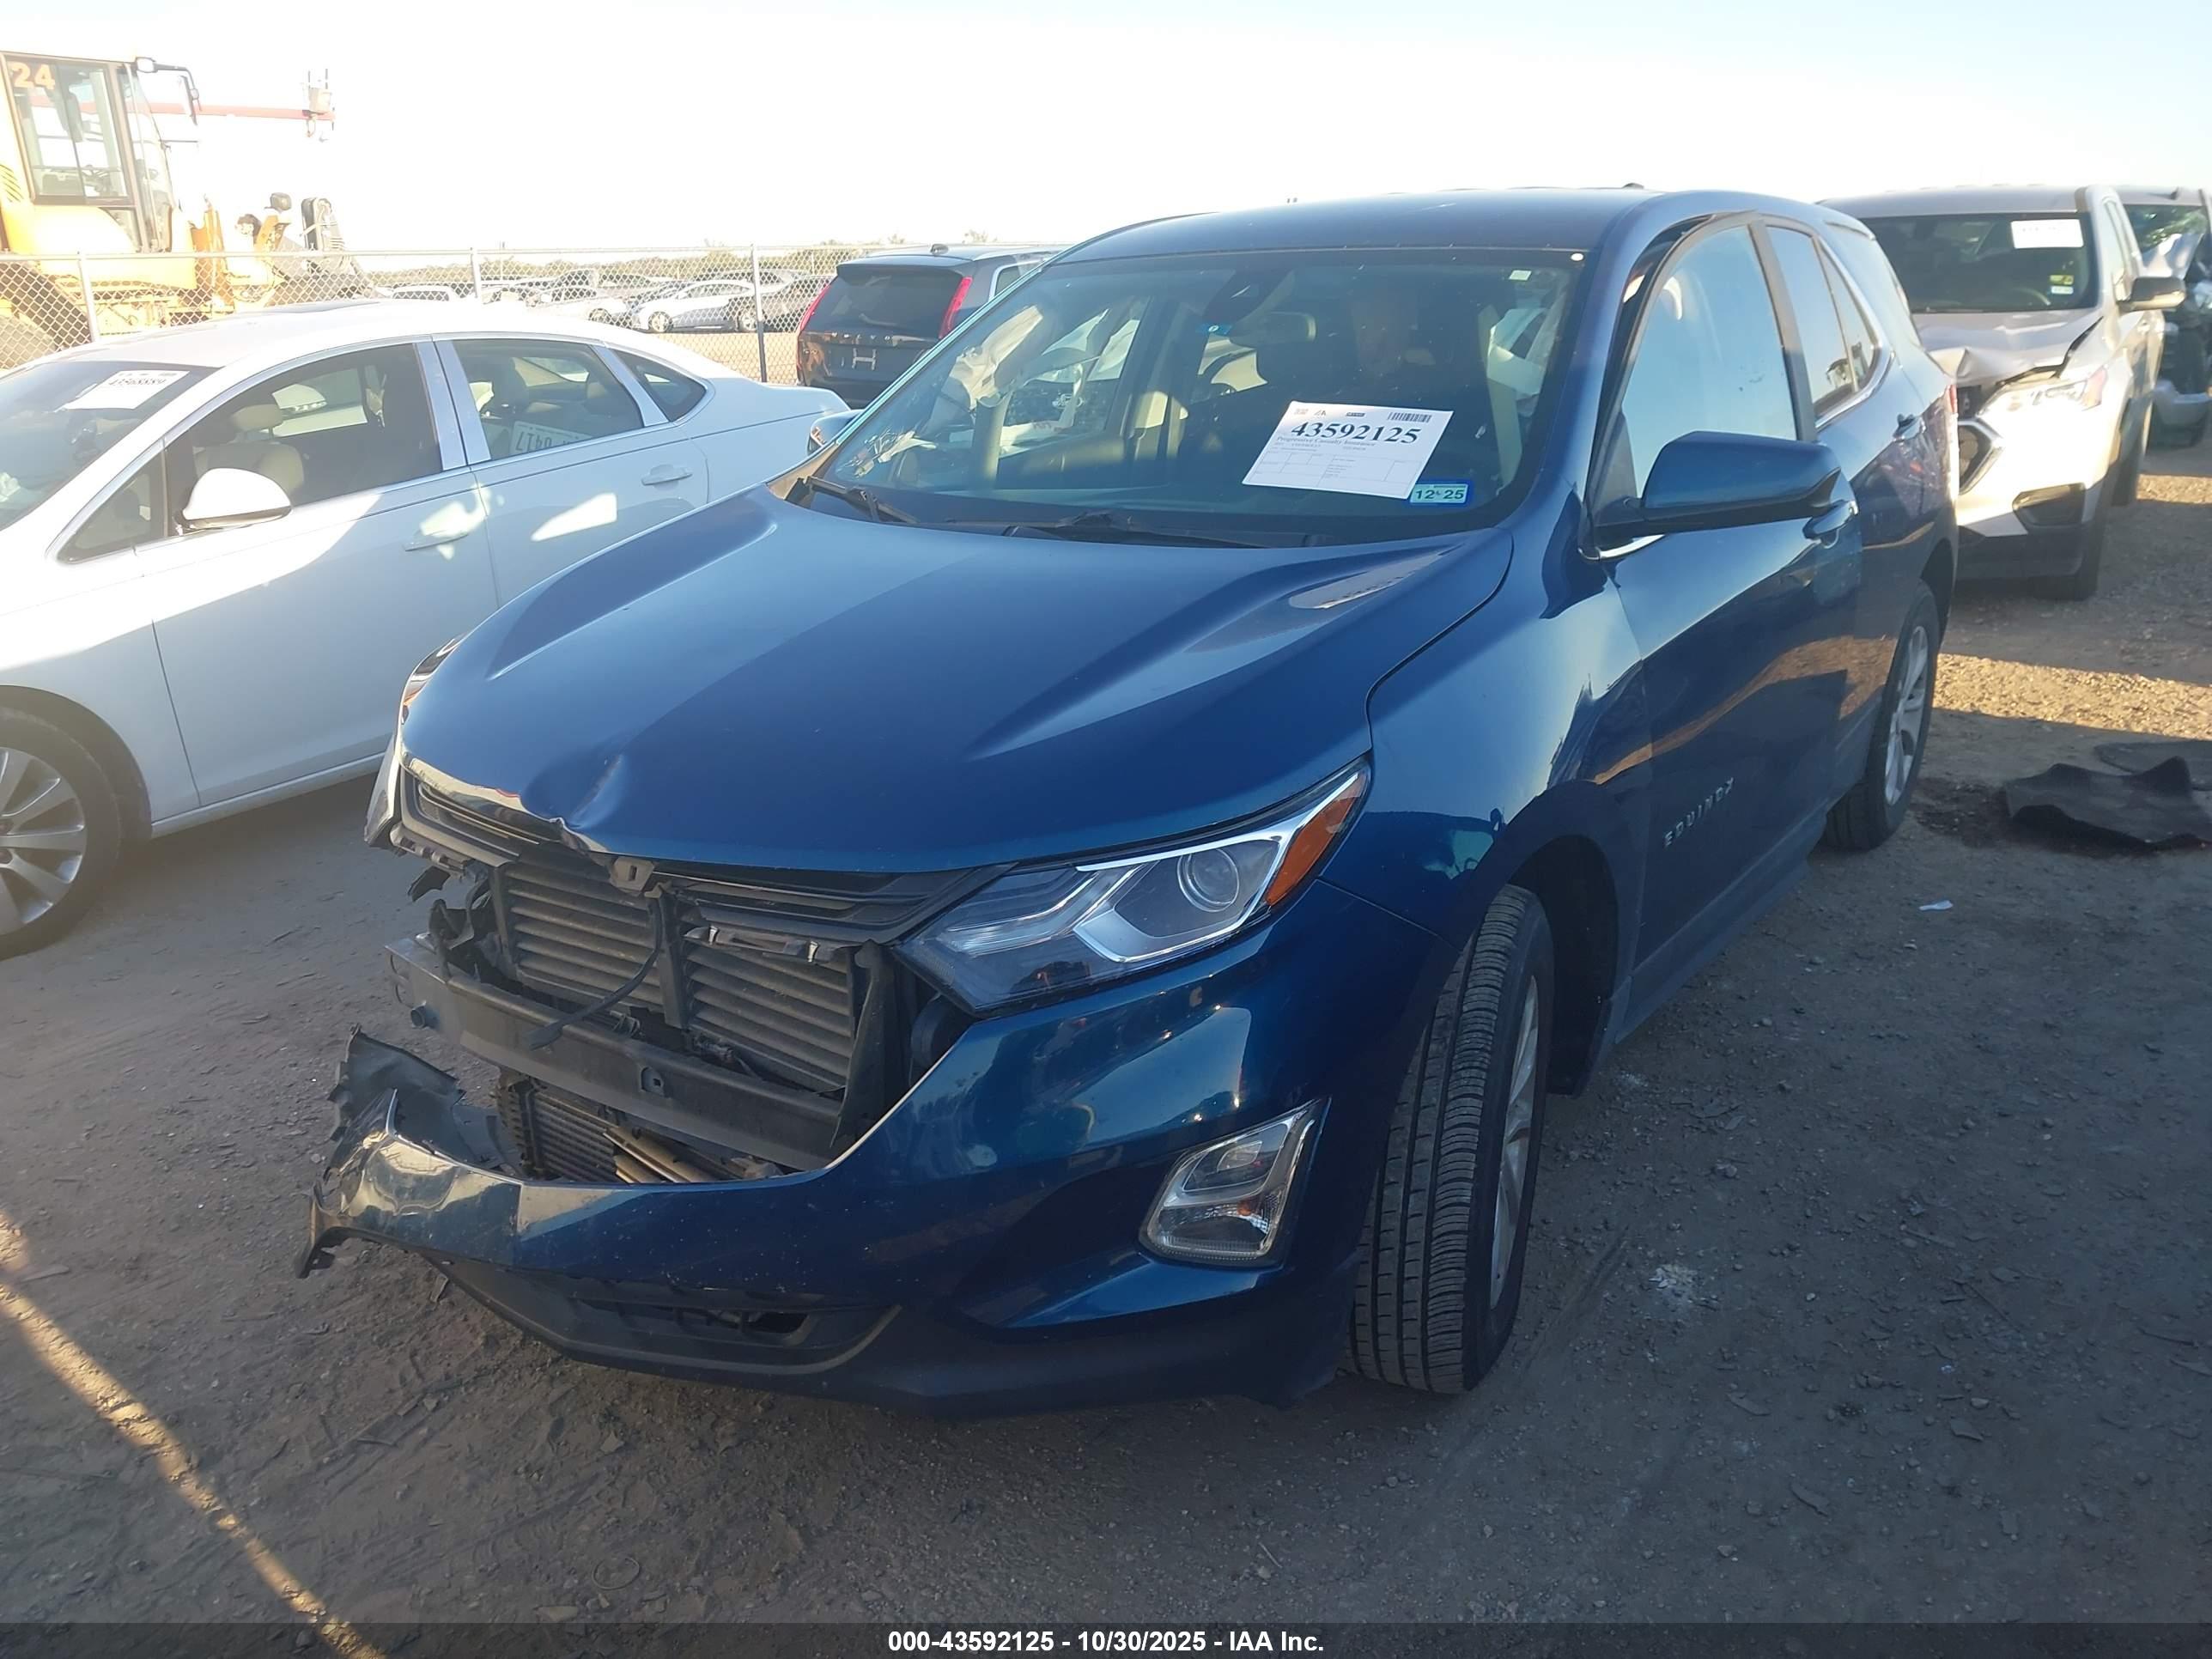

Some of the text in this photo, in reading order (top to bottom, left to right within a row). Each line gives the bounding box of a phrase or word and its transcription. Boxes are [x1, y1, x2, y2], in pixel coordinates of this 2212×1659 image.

[9, 61, 57, 90] 24
[1291, 421, 1421, 444] 43592125
[1415, 489, 1465, 500] 12 25
[1663, 776, 1735, 848] EQUINOX
